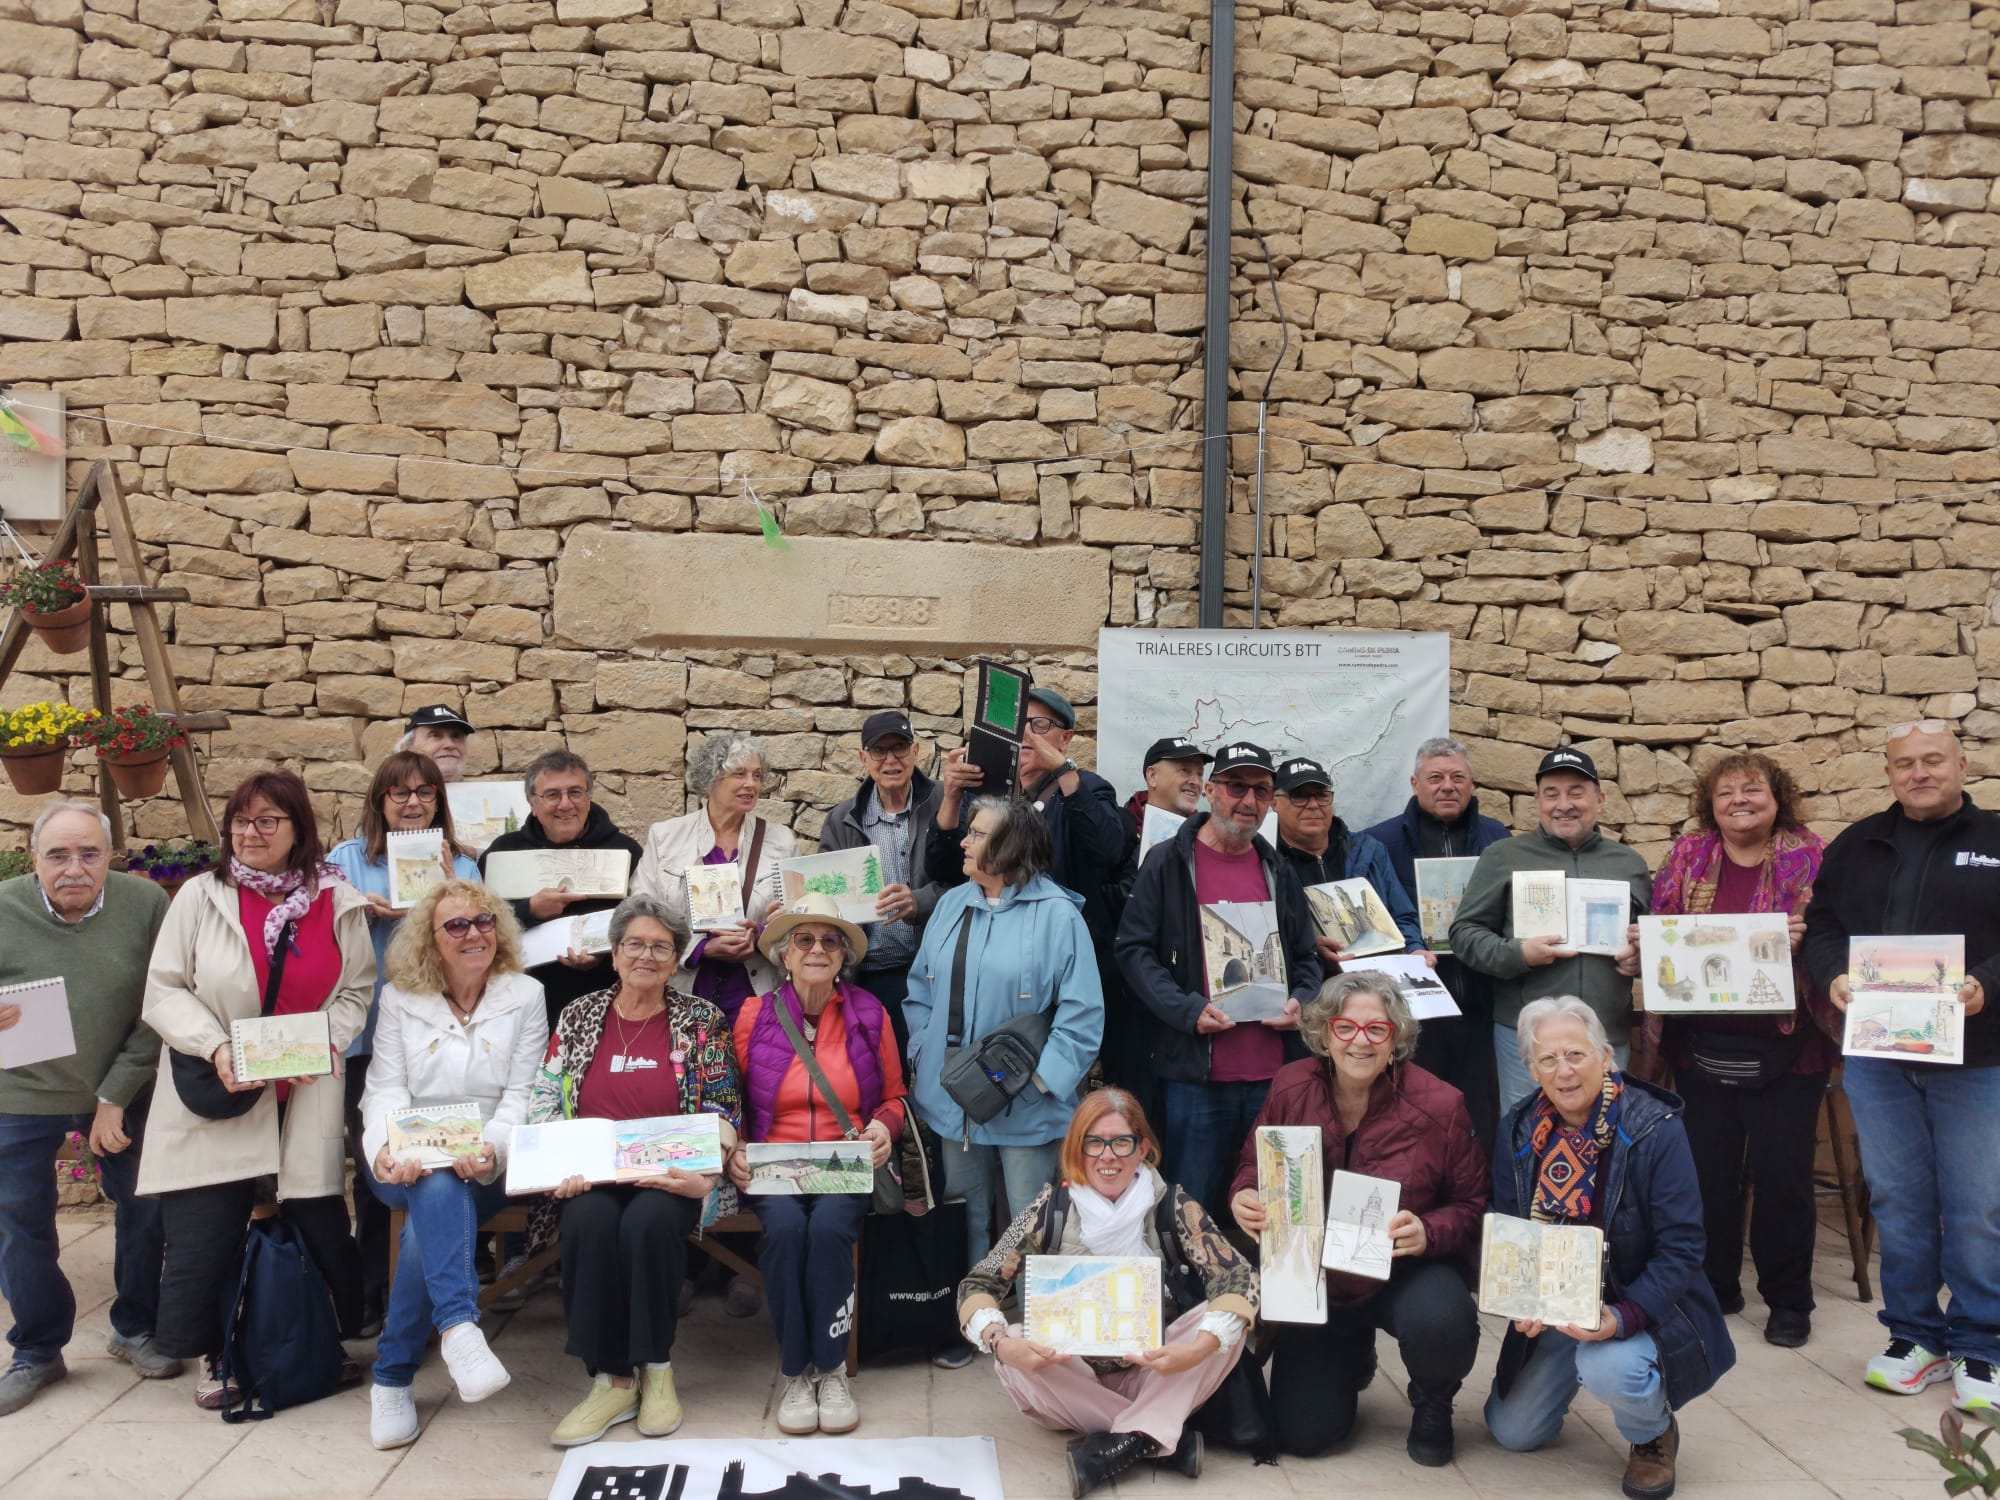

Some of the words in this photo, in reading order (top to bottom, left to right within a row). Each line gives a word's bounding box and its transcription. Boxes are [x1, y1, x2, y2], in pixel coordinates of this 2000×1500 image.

[833, 597, 931, 625] 1898
[1136, 642, 1213, 656] TRIALERES
[1217, 642, 1220, 656] I
[1224, 643, 1291, 657] CIRCUITS
[1295, 643, 1323, 657] BTT
